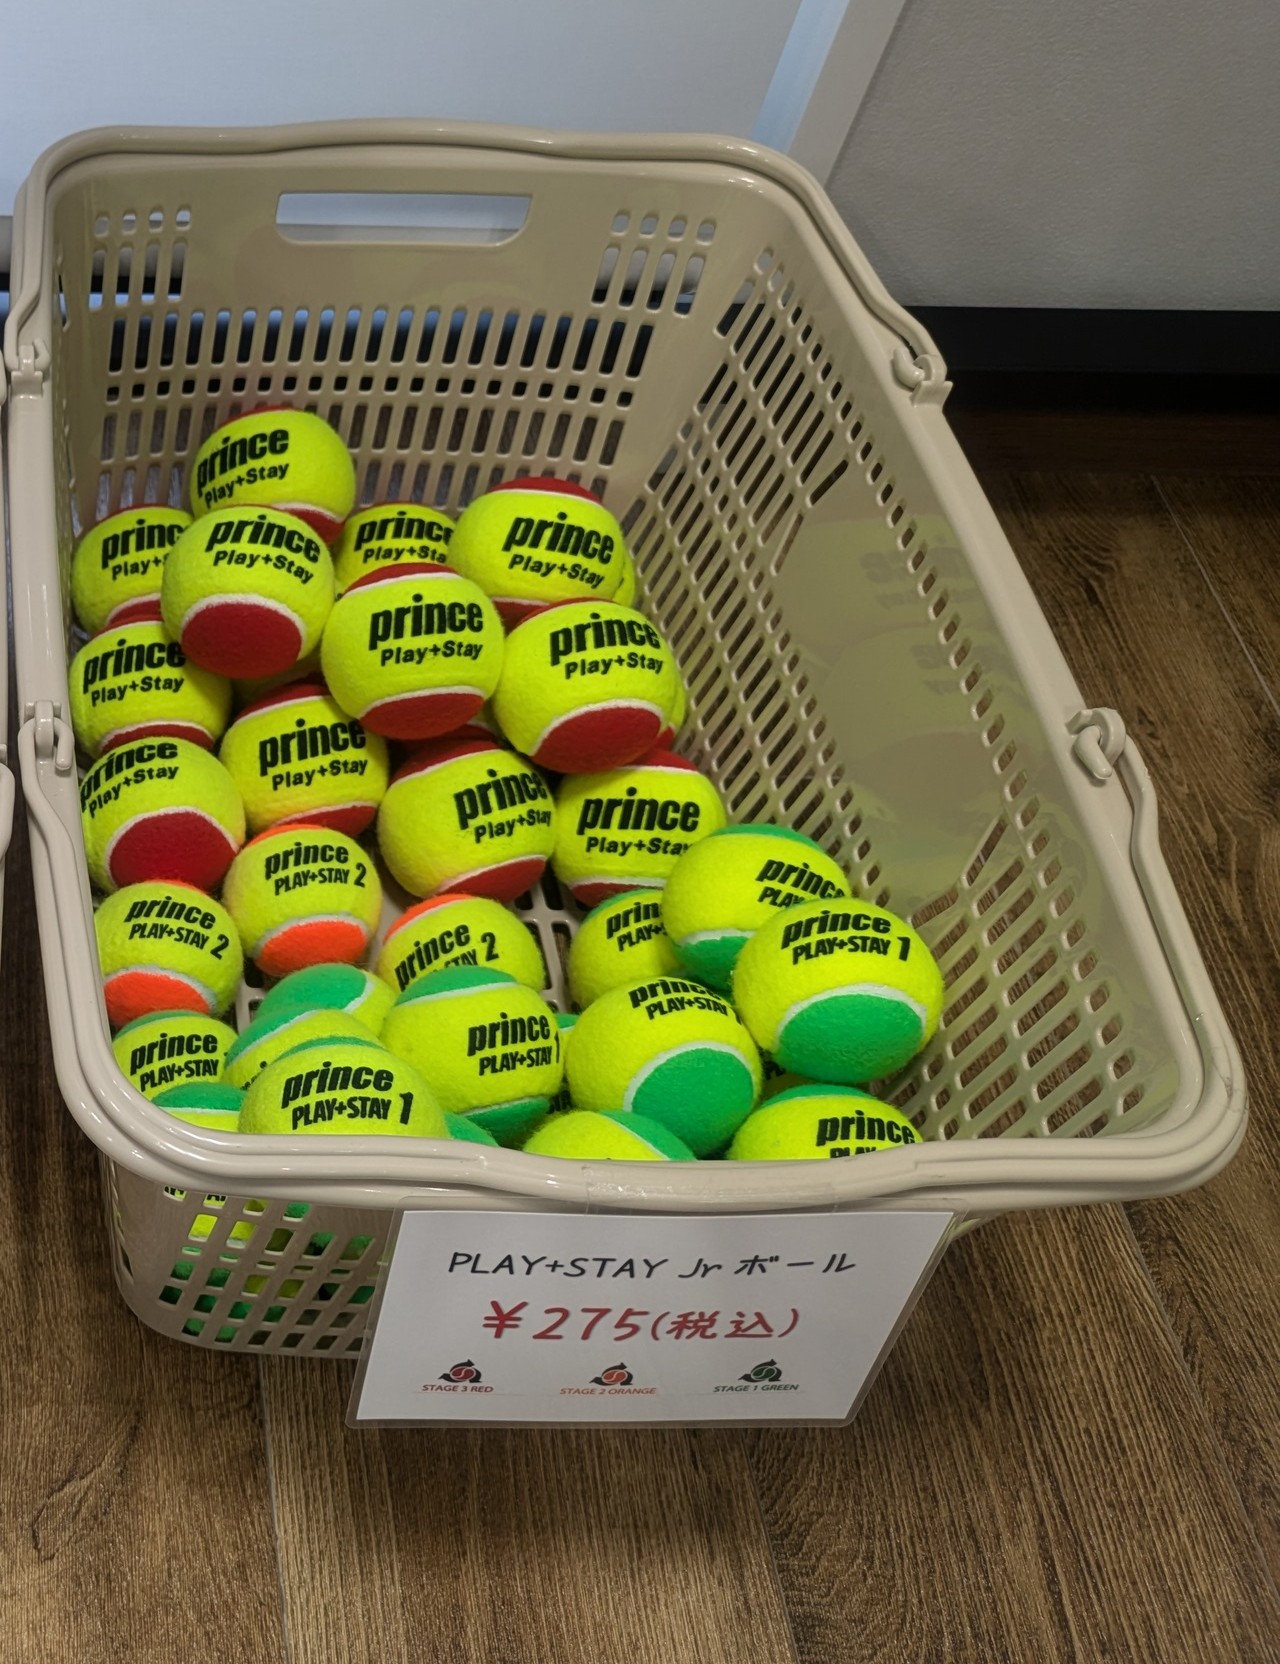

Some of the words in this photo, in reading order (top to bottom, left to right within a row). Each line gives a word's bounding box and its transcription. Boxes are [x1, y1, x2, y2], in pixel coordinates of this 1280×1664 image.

[197, 429, 289, 498] prince
[204, 462, 289, 508] Play+Stay
[102, 518, 184, 570] princ
[205, 514, 320, 564] prince
[363, 545, 447, 564] Play+Sta
[502, 512, 614, 565] prince
[213, 549, 313, 585] Play+Stay
[508, 553, 605, 589] Play+Stay
[369, 594, 483, 651] prince
[550, 612, 660, 666] prince
[82, 639, 186, 694] prince
[380, 640, 483, 666] Play+Stay
[565, 652, 663, 680] Play+Stay
[91, 675, 184, 707] Play+Stay
[258, 718, 366, 776] prince
[81, 742, 178, 813] prince
[89, 766, 179, 819] Play+Stay
[272, 758, 368, 791] Play+Stay
[453, 768, 548, 830] prince
[576, 786, 700, 835] prince
[474, 808, 551, 843] Play+Stay
[265, 842, 349, 880] prince
[274, 867, 350, 896] PLAY+STAY
[354, 863, 368, 888] 2
[124, 896, 216, 930] prince
[606, 902, 660, 939] prin
[781, 910, 892, 949] prince
[128, 922, 210, 950] PLAY+STAY
[210, 934, 230, 960] 2
[394, 924, 471, 992] prince
[481, 932, 499, 961] 2
[792, 935, 891, 965] PLAY+STAY
[898, 936, 911, 962] 1
[467, 1012, 551, 1056] prince
[130, 1032, 218, 1075] prince
[479, 1045, 553, 1076] PLAY+STAY
[140, 1059, 219, 1092] PLAY+STAY
[281, 1061, 394, 1109] prince
[291, 1096, 392, 1130] PLAY+STAY
[399, 1091, 413, 1125] 1
[815, 1109, 915, 1147] prince
[448, 1251, 669, 1279] PLAY+STAY
[678, 1257, 723, 1279] Jr
[734, 1253, 856, 1275] ボール
[422, 1384, 459, 1392] STAGE
[470, 1385, 494, 1393] RED
[560, 1387, 596, 1395] STAGE
[608, 1387, 656, 1395] ORANGE
[713, 1384, 749, 1393] STAGE
[761, 1384, 799, 1392] GREEN
